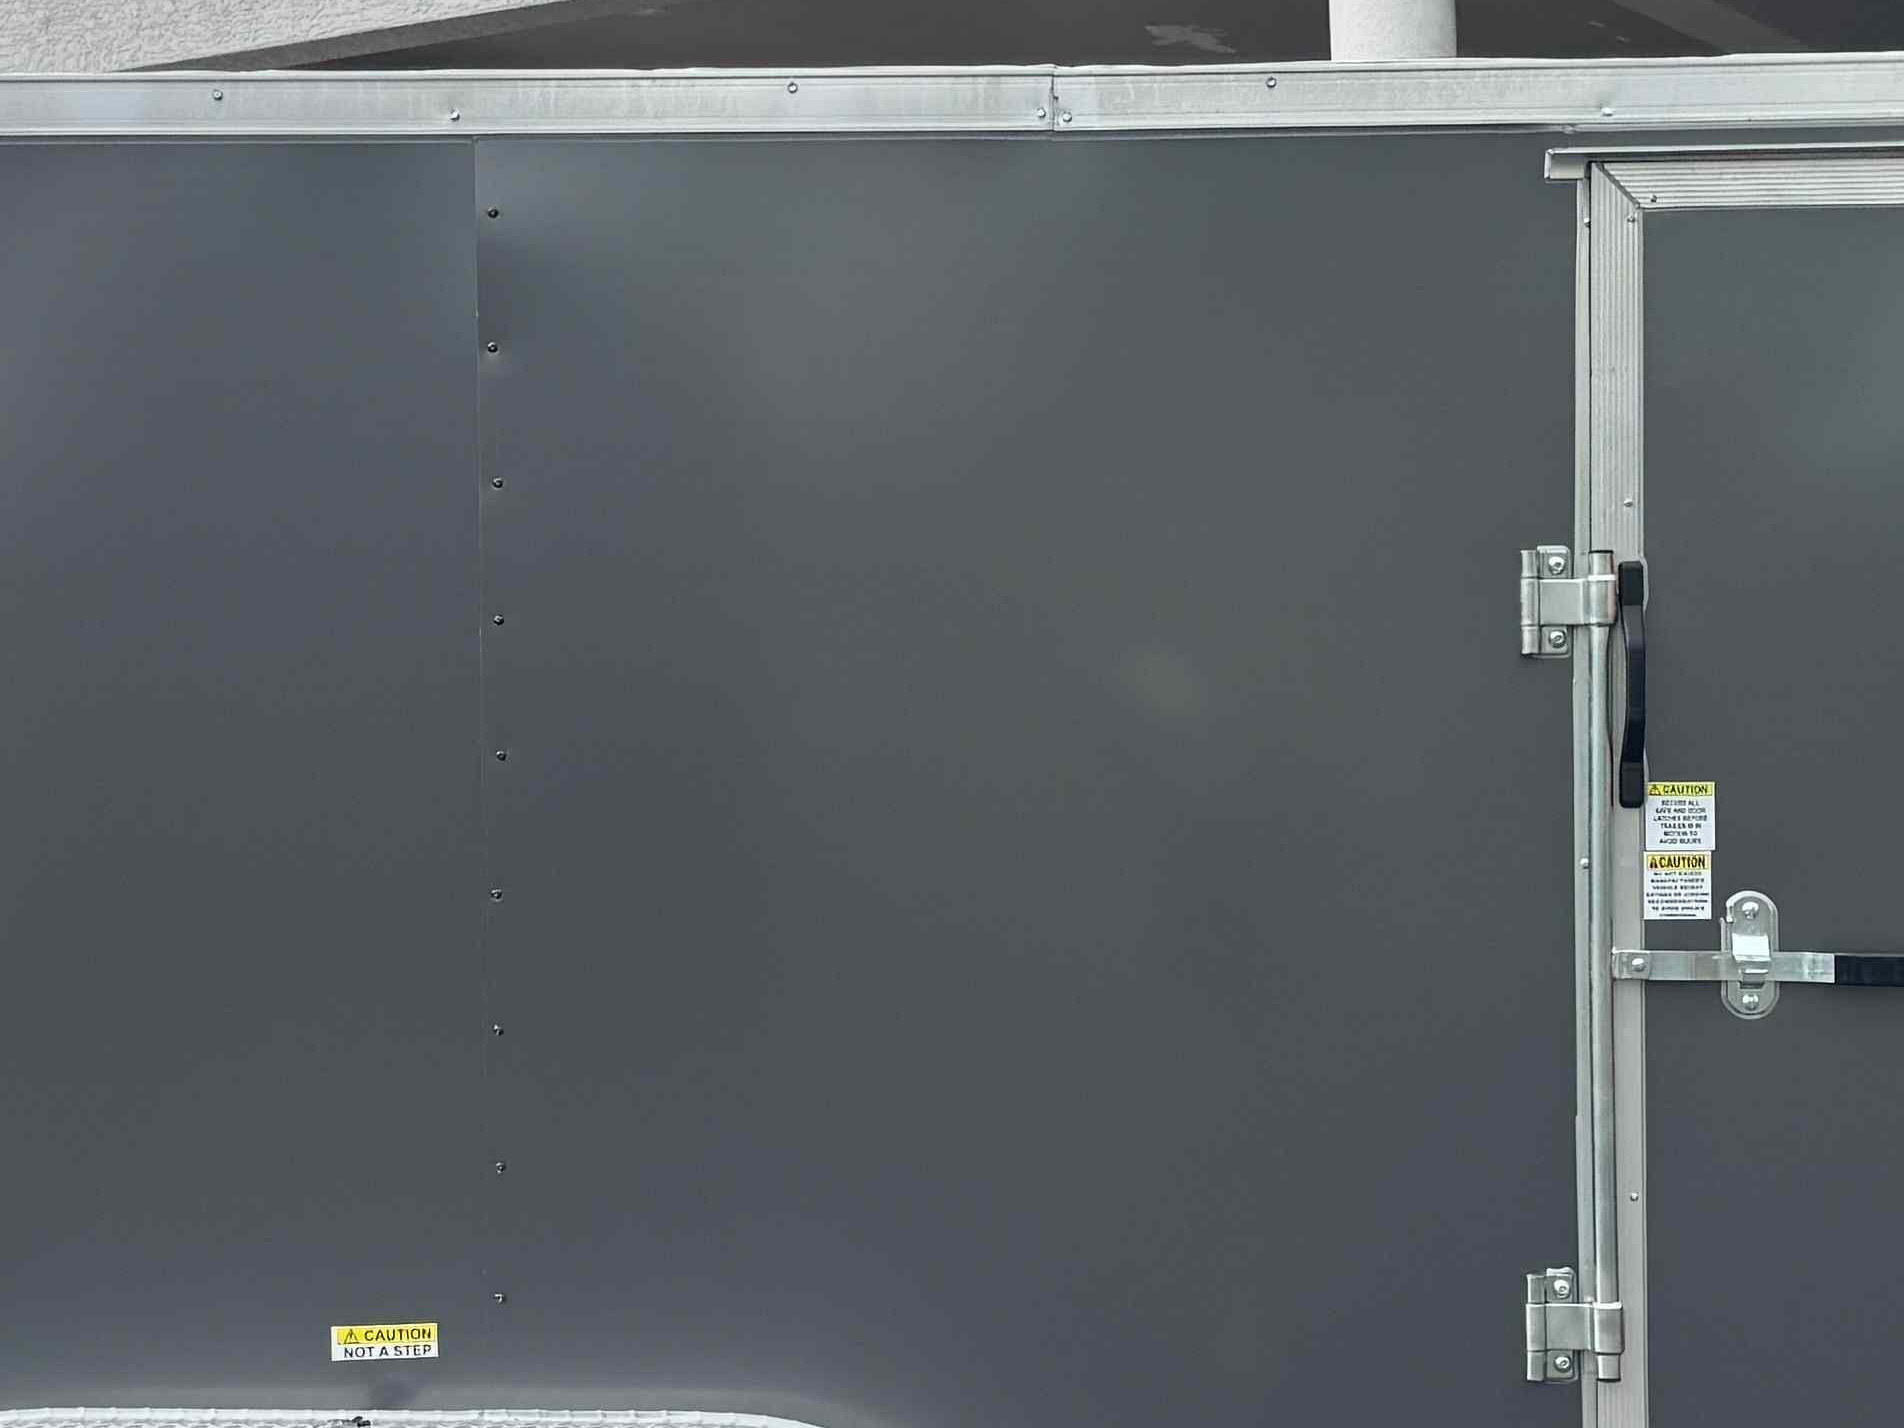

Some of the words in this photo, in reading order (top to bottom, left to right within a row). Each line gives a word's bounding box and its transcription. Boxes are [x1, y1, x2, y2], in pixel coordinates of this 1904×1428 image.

[1663, 784, 1708, 795] CAUTION
[1659, 855, 1706, 869] CAUTION
[364, 1328, 431, 1342] CAUTION
[344, 1347, 375, 1358] NOT
[379, 1346, 389, 1357] A
[394, 1344, 432, 1356] STEP
